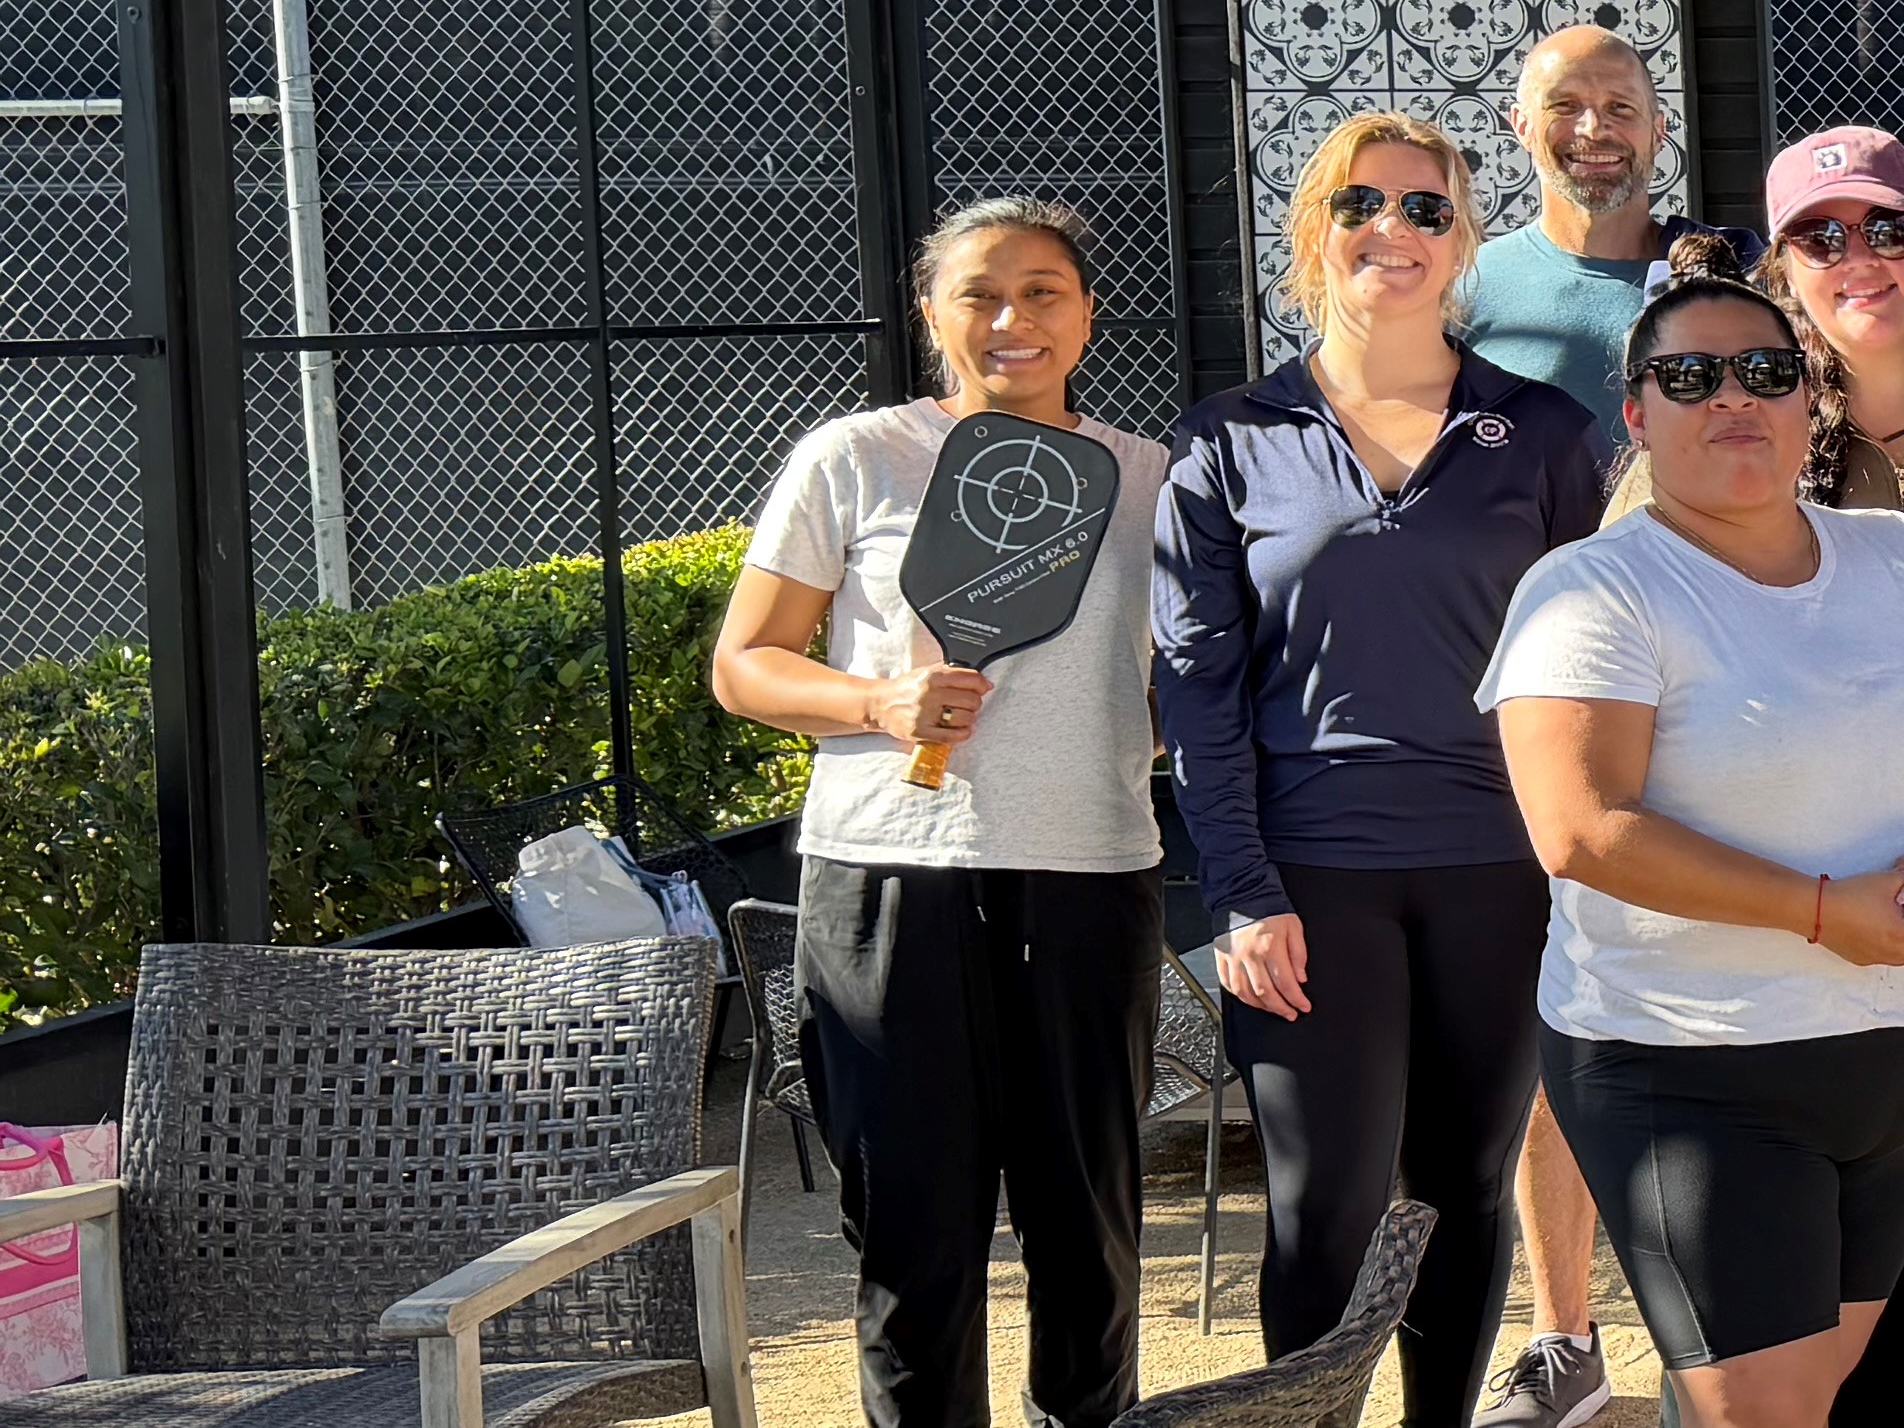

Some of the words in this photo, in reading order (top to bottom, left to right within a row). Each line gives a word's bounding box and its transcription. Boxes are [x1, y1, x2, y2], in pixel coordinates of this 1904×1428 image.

[966, 558, 1036, 604] PURSUIT
[1038, 543, 1065, 566] MX
[1064, 530, 1089, 549] 6.0
[1048, 549, 1081, 573] PRO
